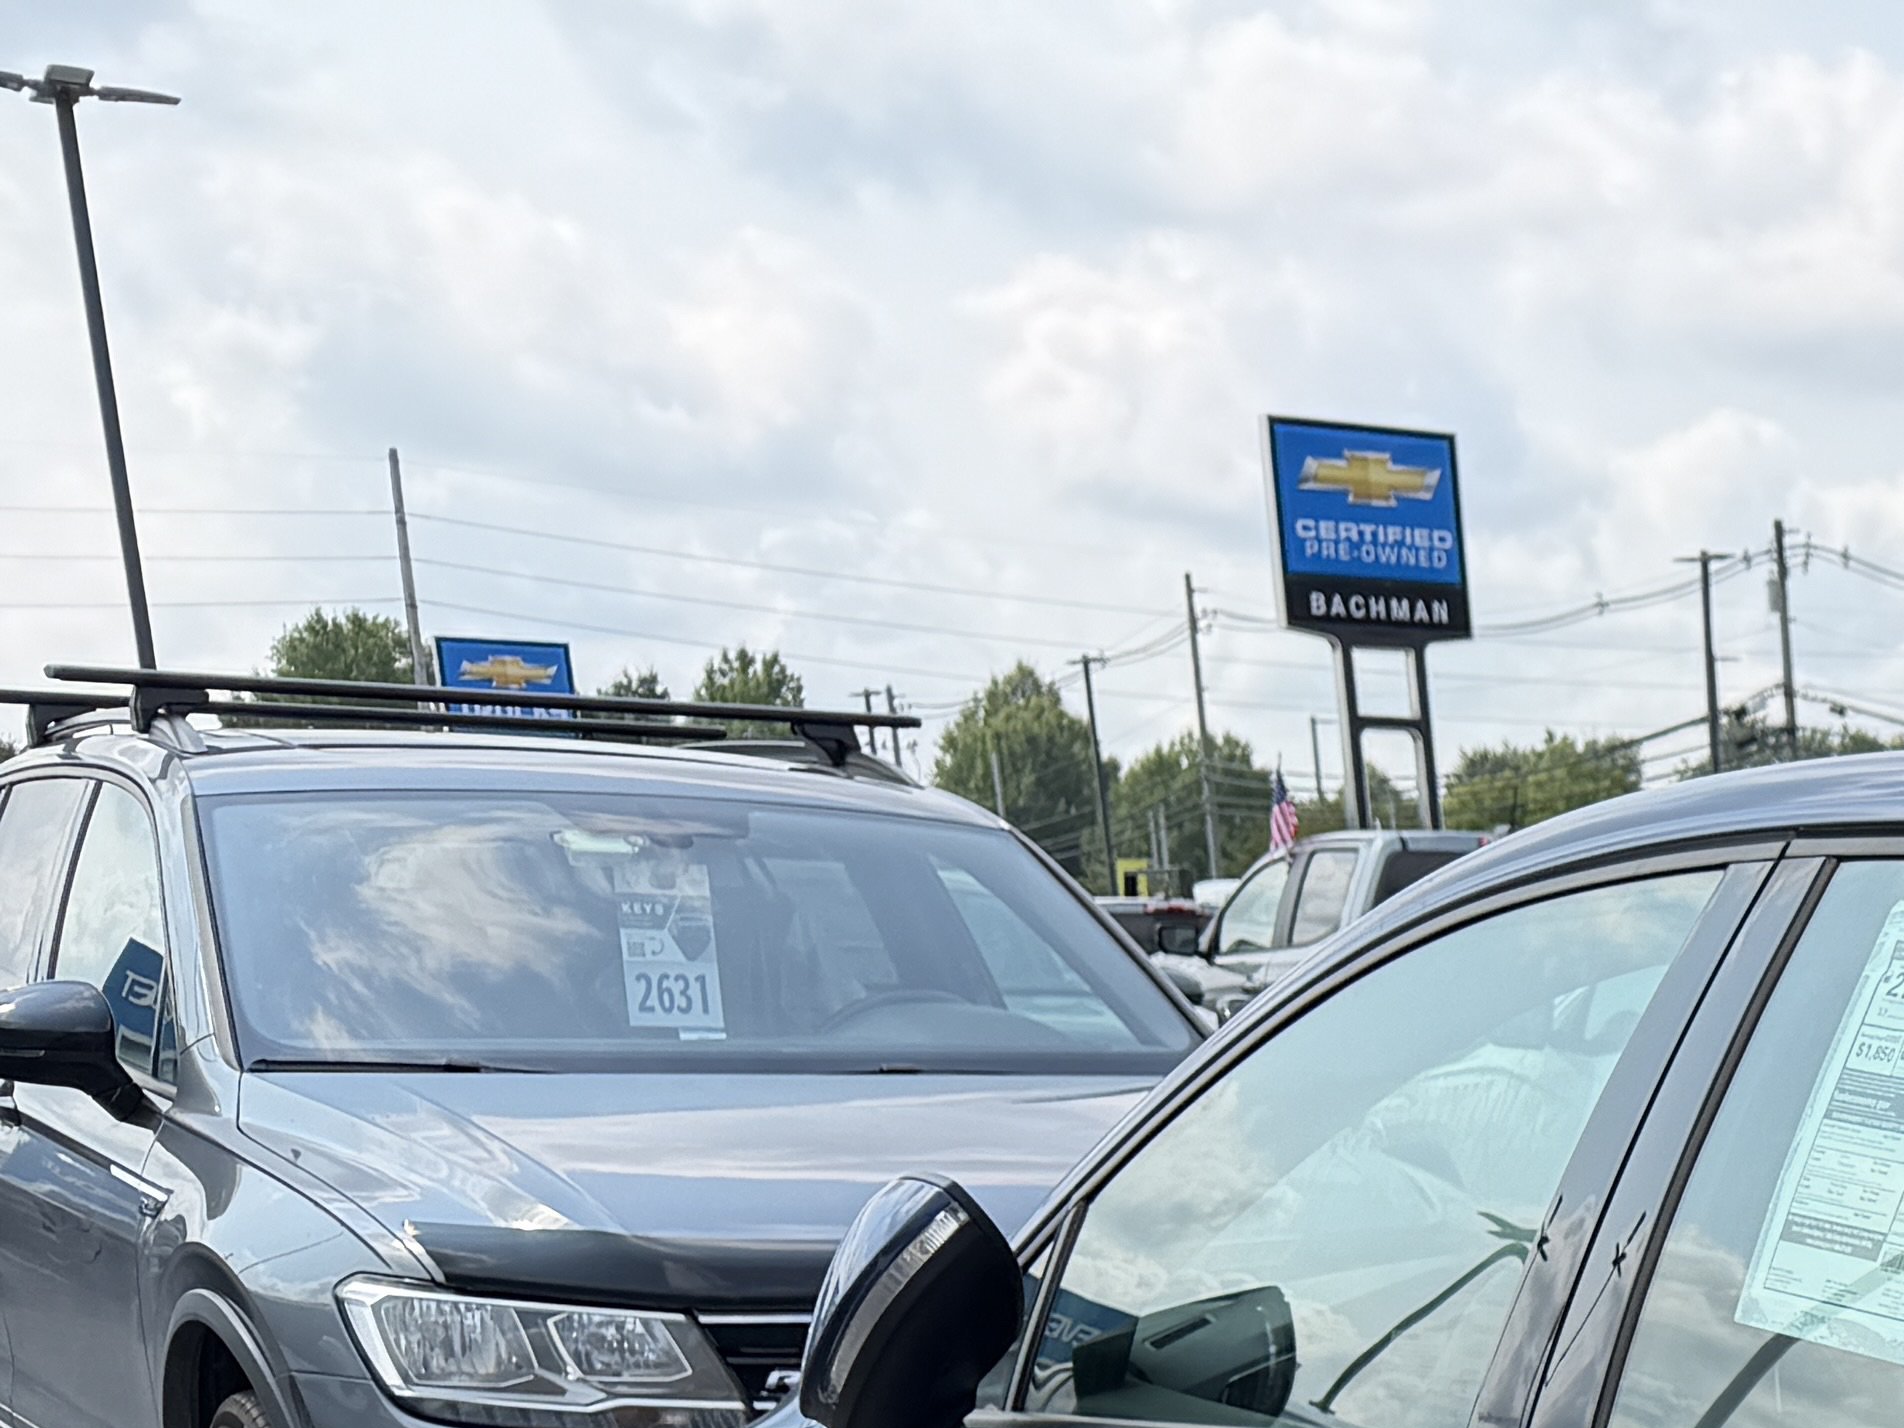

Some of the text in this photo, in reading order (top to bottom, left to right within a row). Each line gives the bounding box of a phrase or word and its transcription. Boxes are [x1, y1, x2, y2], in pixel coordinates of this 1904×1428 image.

[1295, 518, 1453, 550] CERTIFIED
[1304, 539, 1448, 568] PRE-OWNED
[1309, 591, 1450, 624] BACHMAN
[621, 902, 664, 916] KEYS
[635, 971, 710, 1015] 2631
